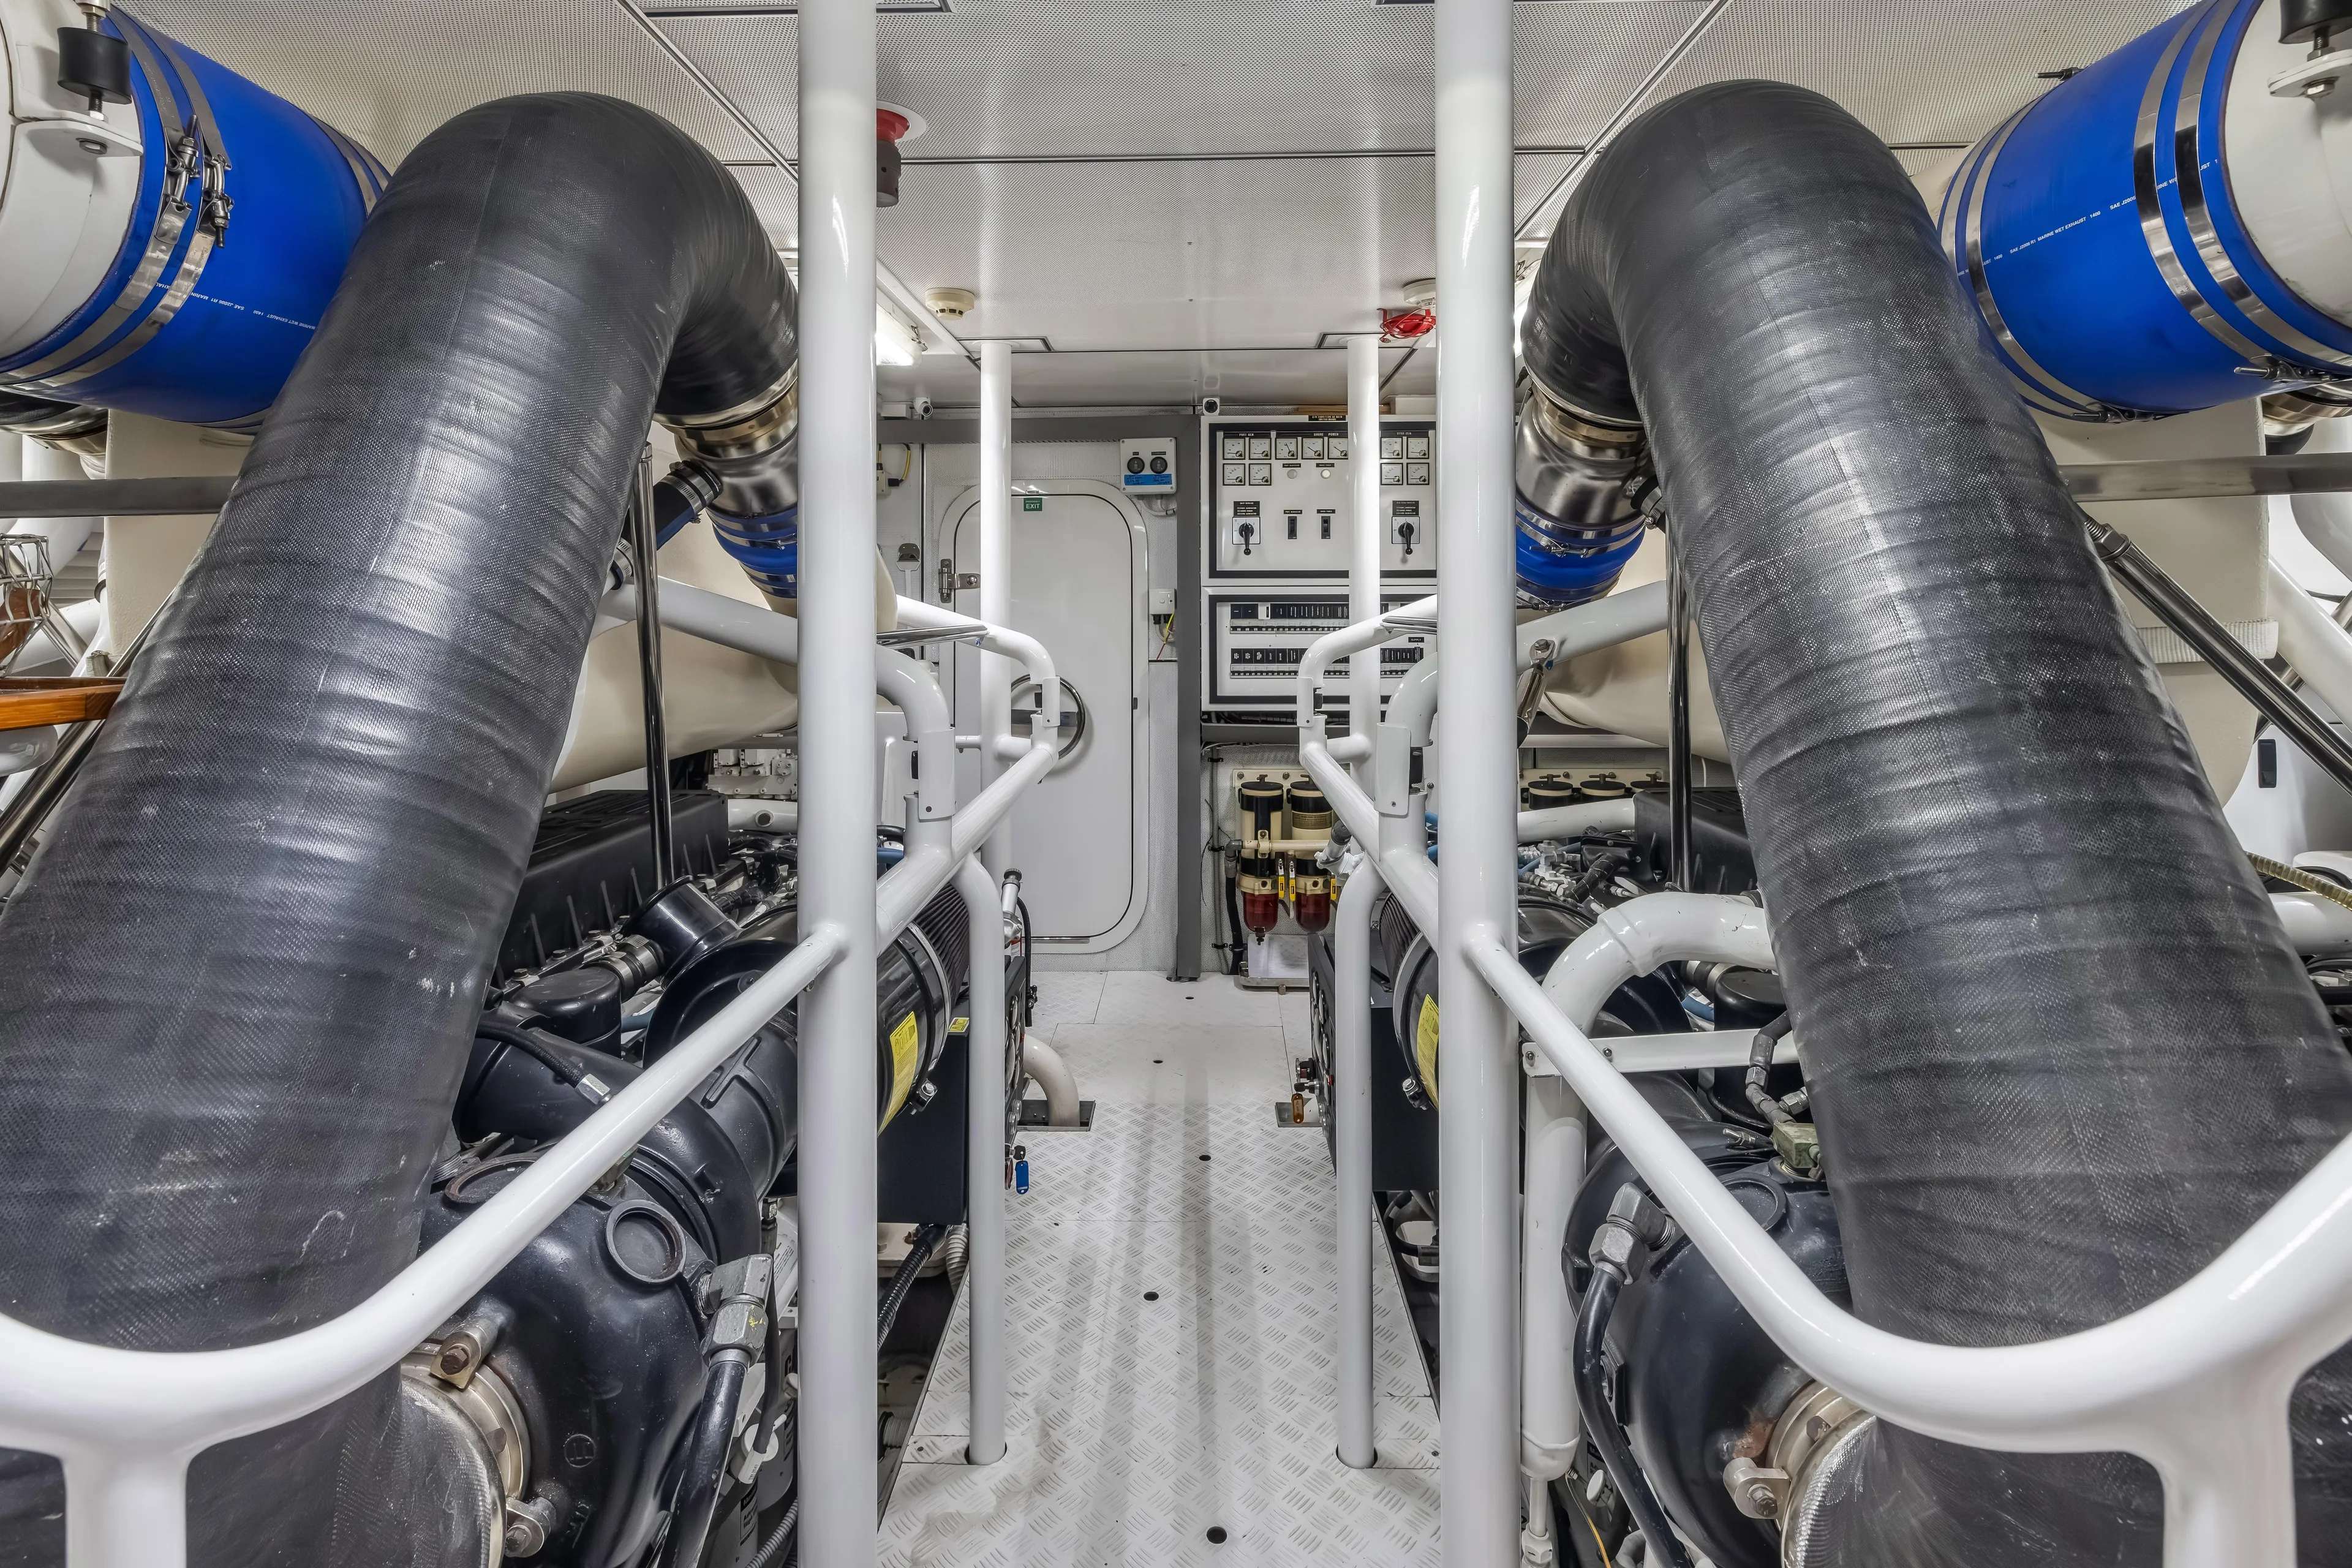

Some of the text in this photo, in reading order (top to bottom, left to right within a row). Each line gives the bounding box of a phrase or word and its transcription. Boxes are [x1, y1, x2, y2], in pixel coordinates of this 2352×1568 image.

[2037, 231, 2054, 241] MARINE
[2065, 216, 2087, 230] EXHAUST
[266, 314, 288, 323] EXHAUST
